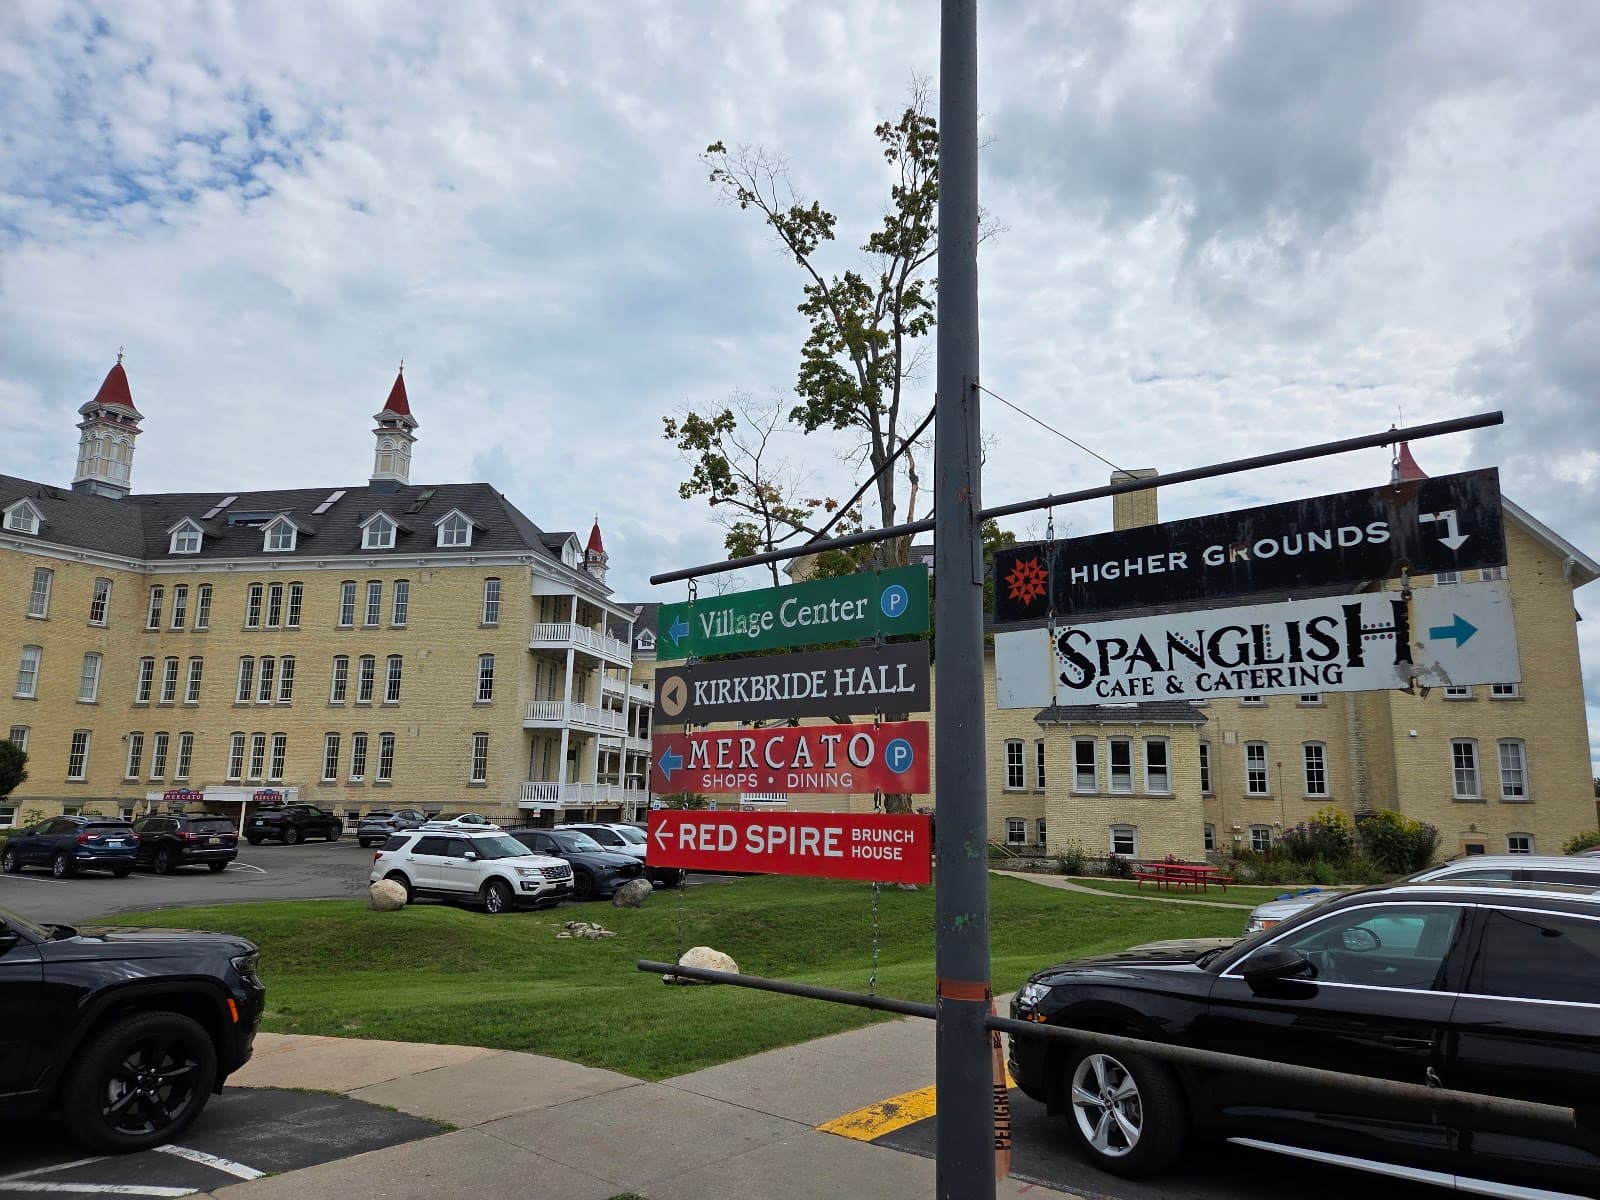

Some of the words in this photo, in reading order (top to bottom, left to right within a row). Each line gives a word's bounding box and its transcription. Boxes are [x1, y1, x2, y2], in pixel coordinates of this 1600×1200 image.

[1071, 551, 1188, 584] HIGHER
[1203, 521, 1390, 566] GROUNDS
[700, 608, 774, 639] Village
[780, 597, 868, 628] Center
[1051, 600, 1413, 690] SPANGLISH
[694, 670, 828, 706] KIRKBRIDE
[833, 663, 916, 696] HALL
[1096, 675, 1154, 698] CAFE
[1166, 675, 1184, 694] &
[1195, 663, 1344, 693] CATERING
[687, 732, 875, 770] MERCATO
[702, 773, 758, 788] SHOPS
[787, 773, 853, 788] DINING
[679, 823, 738, 852] RED
[745, 825, 843, 857] SPIRE
[852, 828, 914, 843] BRUNCH
[852, 846, 903, 860] HOUSE
